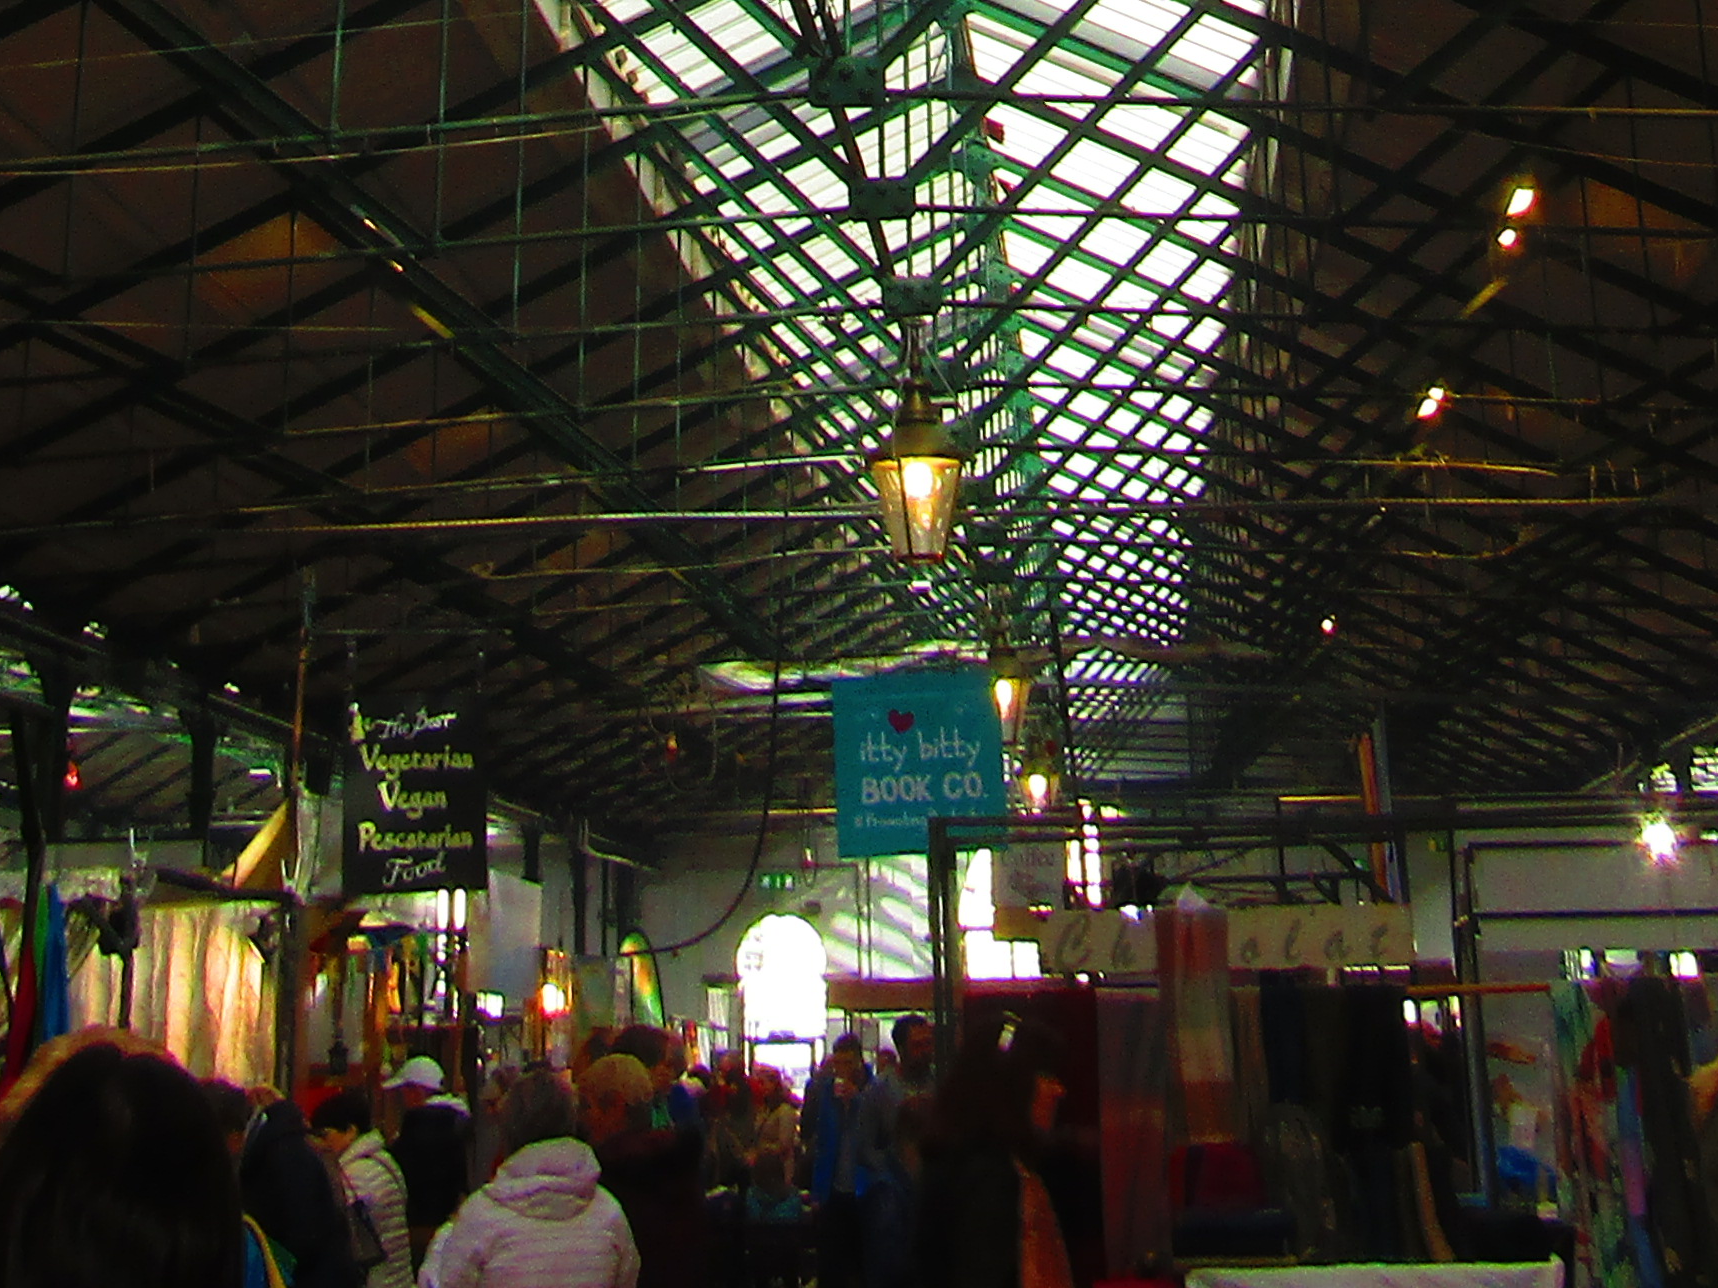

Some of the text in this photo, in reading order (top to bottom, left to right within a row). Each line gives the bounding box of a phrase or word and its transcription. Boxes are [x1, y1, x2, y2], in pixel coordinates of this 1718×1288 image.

[359, 743, 475, 781] Vegetarian
[860, 725, 981, 773] itty bitty
[377, 780, 448, 820] Vegan
[861, 775, 933, 805] BOOK
[383, 851, 447, 887] Food
